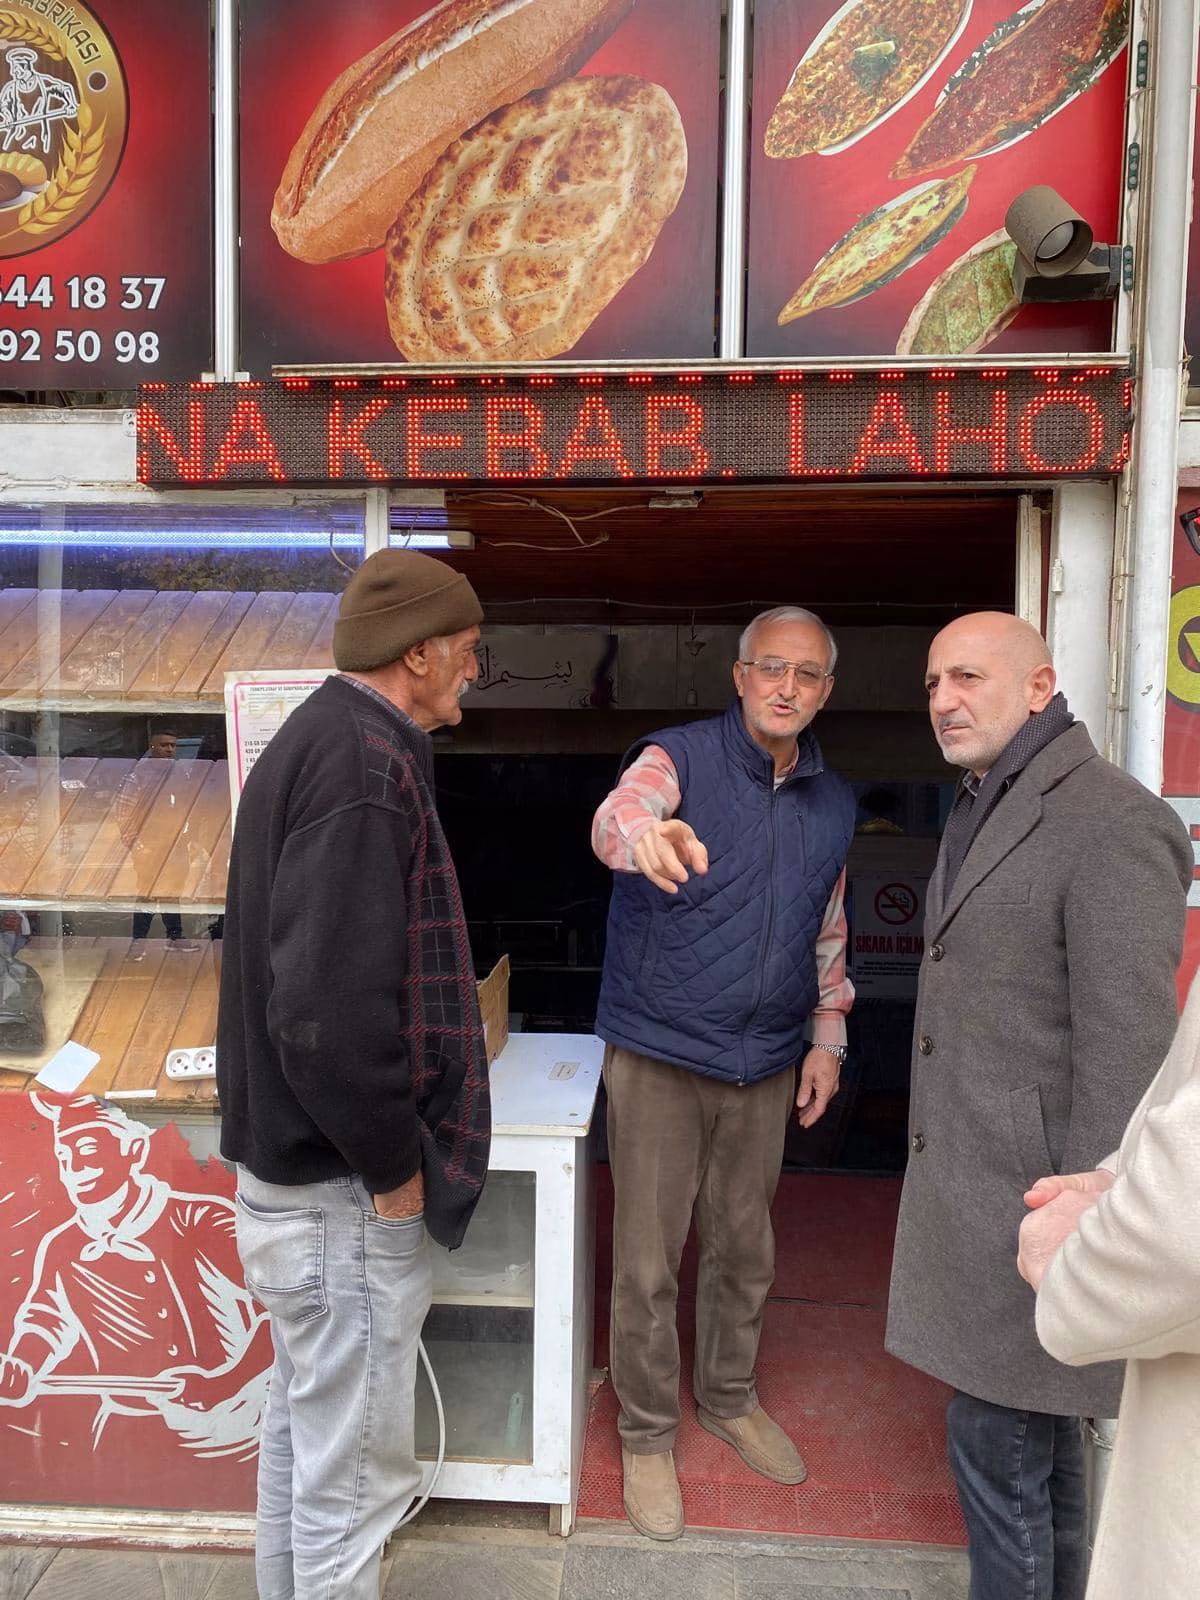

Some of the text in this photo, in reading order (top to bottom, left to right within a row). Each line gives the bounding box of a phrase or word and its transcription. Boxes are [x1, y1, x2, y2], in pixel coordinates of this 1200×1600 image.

[8, 0, 101, 64] BRİKASI
[0, 276, 167, 310] 44 18 37
[0, 329, 160, 364] 92 50 98
[136, 400, 286, 481] NA
